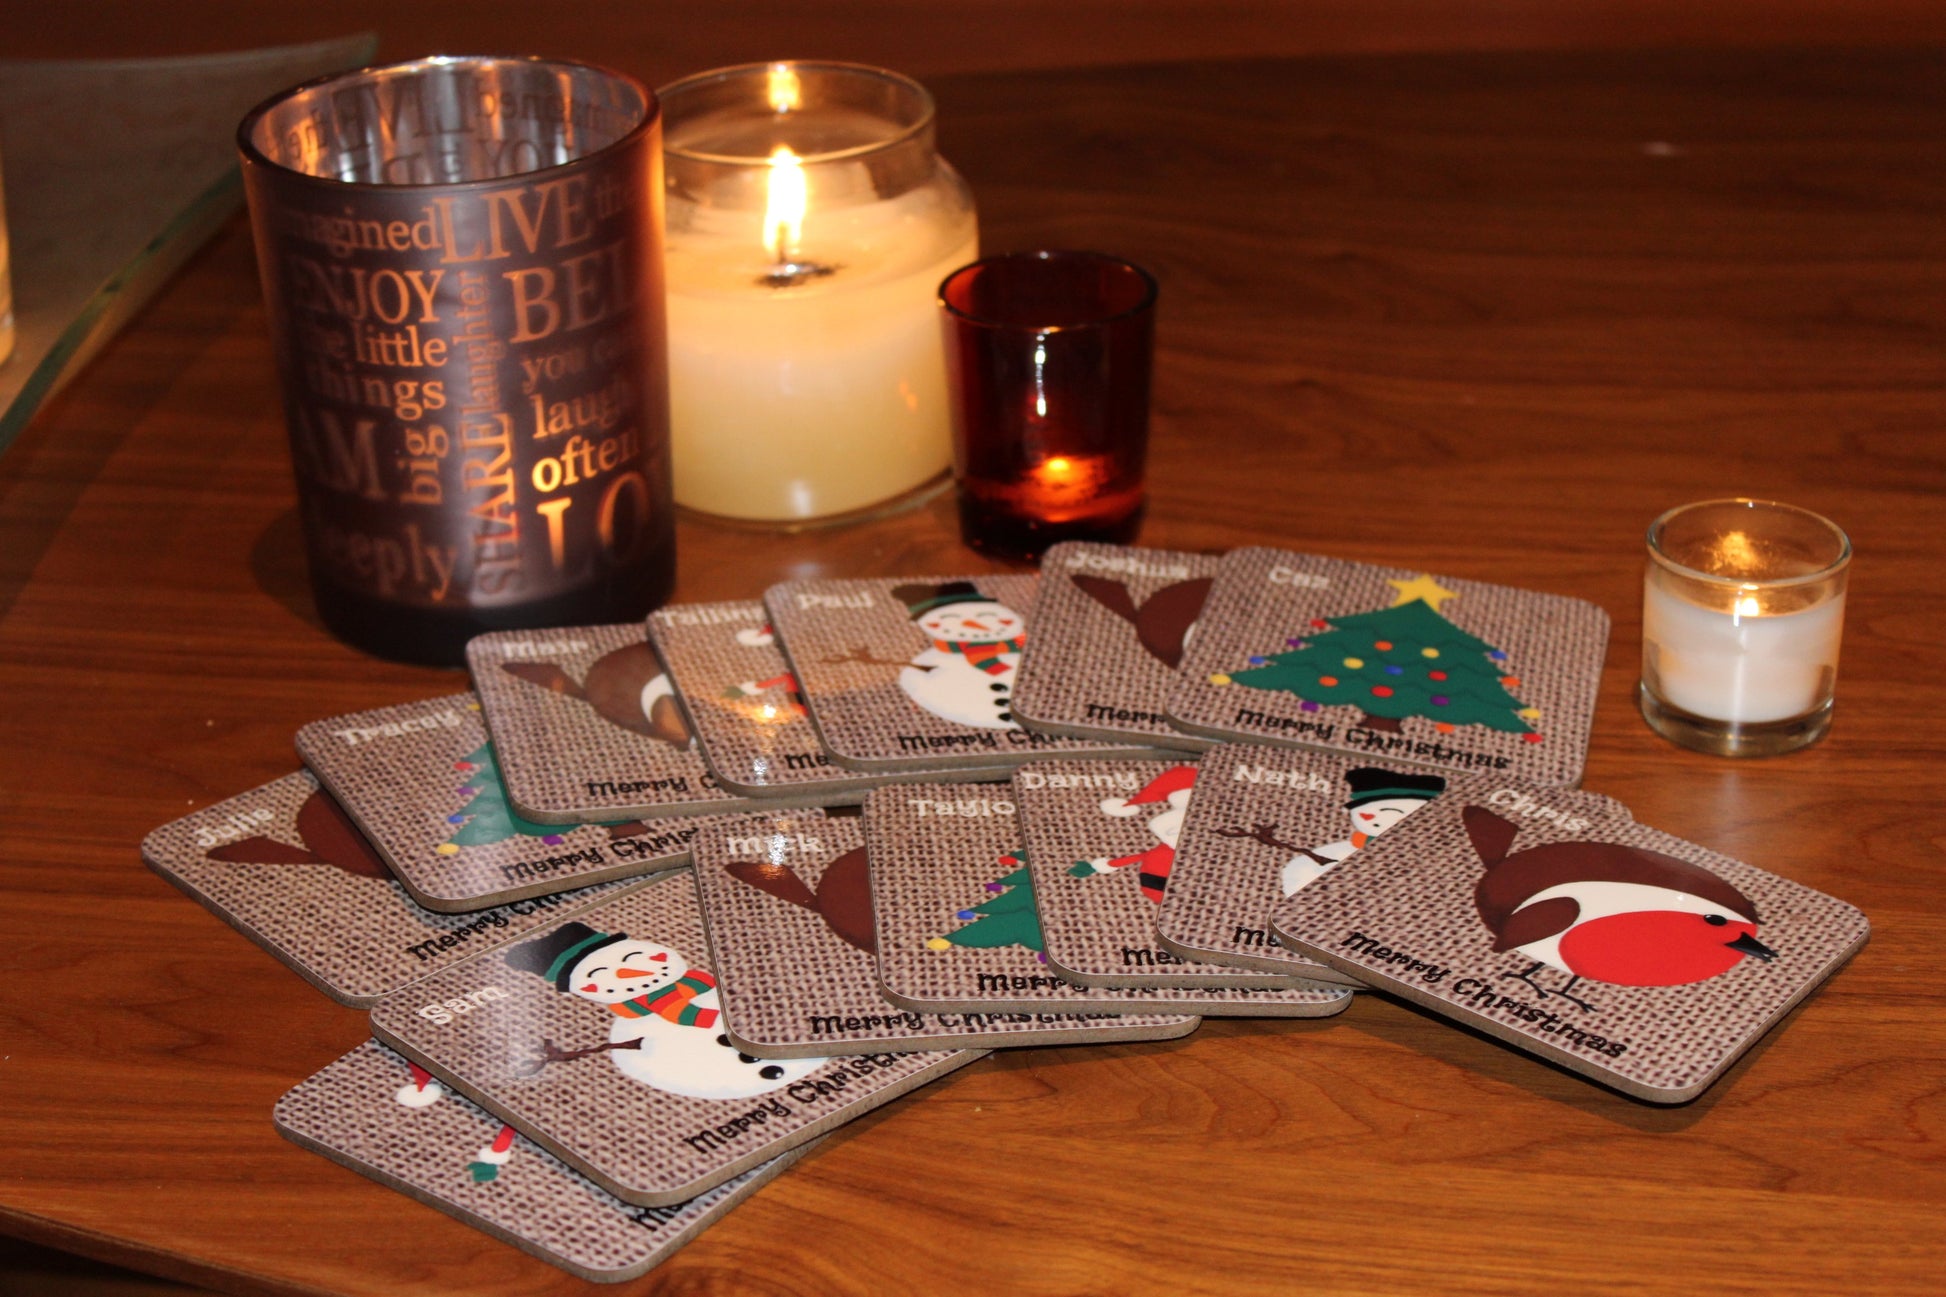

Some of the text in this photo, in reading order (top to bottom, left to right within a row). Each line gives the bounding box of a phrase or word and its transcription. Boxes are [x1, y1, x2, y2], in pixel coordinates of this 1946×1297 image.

[433, 172, 592, 264] LIVE
[351, 320, 449, 368] little
[453, 270, 506, 416] laughter
[396, 424, 450, 505] big
[531, 428, 641, 494] often
[458, 411, 521, 597] SHARE
[1345, 726, 1512, 770] Christmas
[1021, 771, 1138, 791] Danny
[1233, 764, 1334, 795] Nath
[193, 806, 274, 847] Julie
[1489, 788, 1592, 833] Chris
[417, 985, 510, 1025] Sam
[1340, 931, 1628, 1059] Merry Christmas
[683, 1098, 792, 1155] Merry
